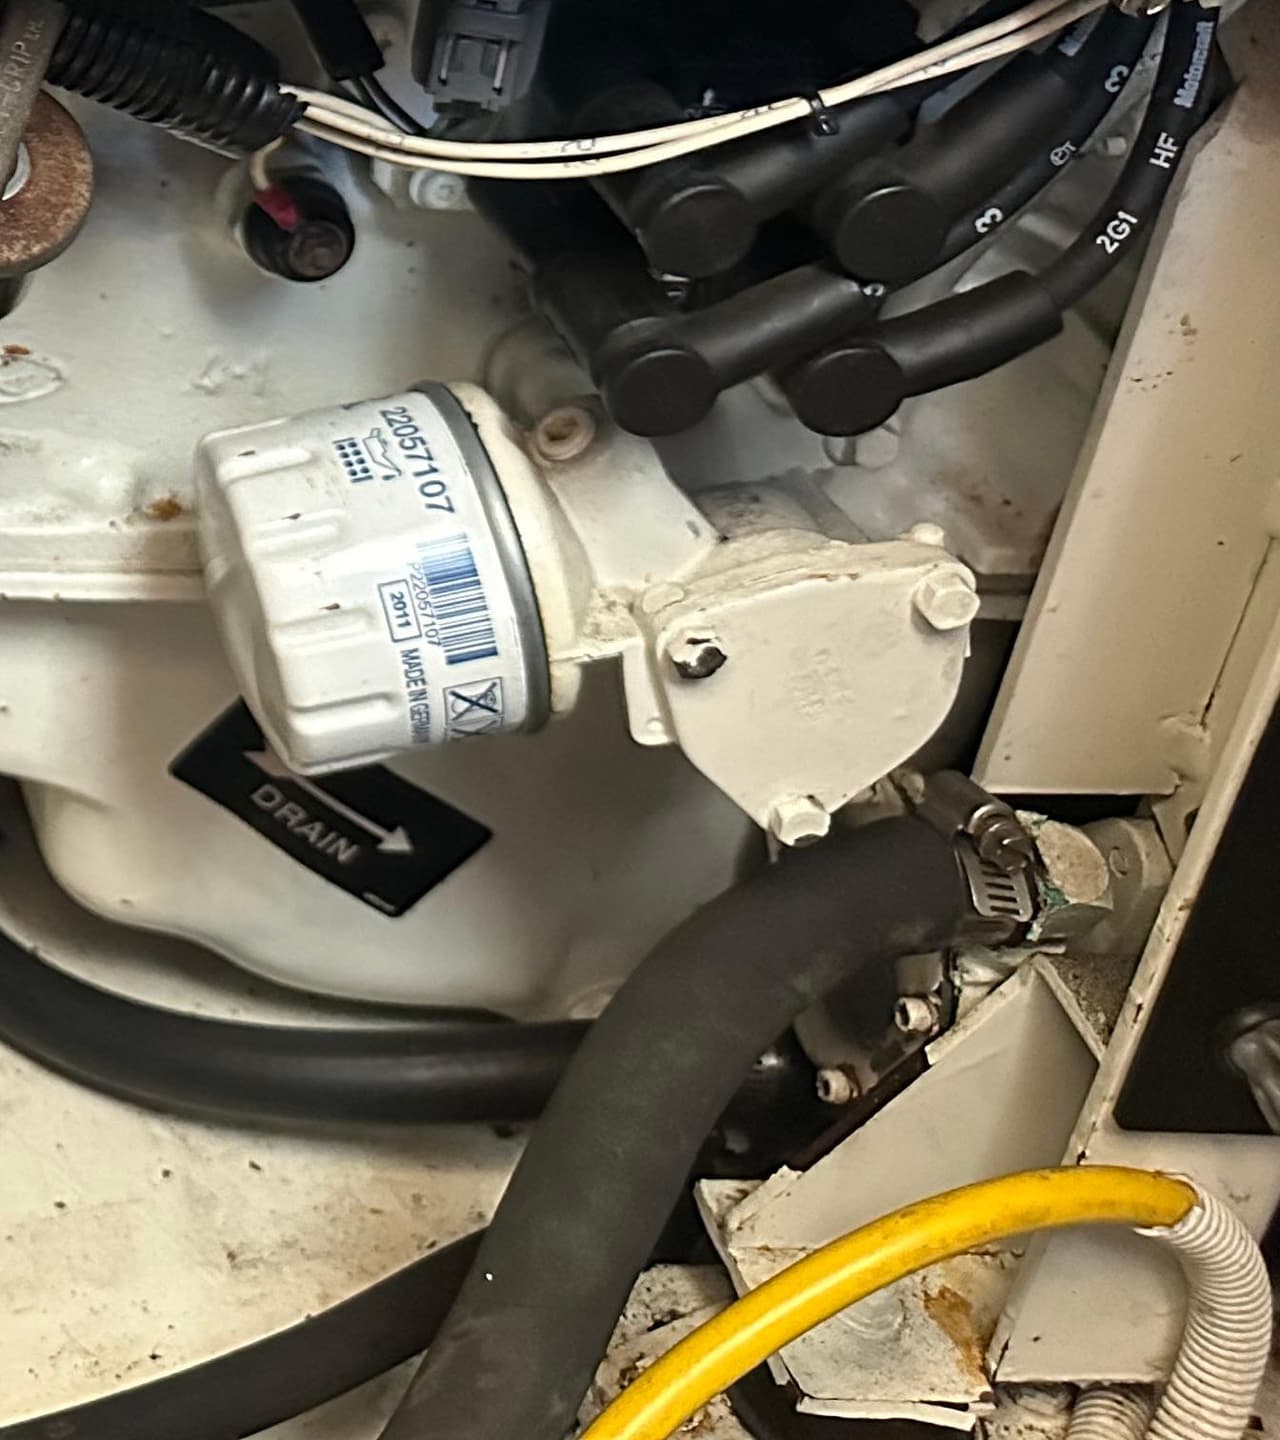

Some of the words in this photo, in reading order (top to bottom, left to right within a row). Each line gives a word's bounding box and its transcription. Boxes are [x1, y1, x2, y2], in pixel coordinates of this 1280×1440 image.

[1104, 64, 1130, 94] 3
[1149, 132, 1180, 169] HF
[973, 206, 1005, 235] 3
[1095, 210, 1140, 256] 2G1
[379, 405, 456, 514] 22057107
[389, 590, 412, 630] 2011
[400, 647, 427, 687] MADE
[407, 687, 429, 702] IN
[250, 782, 361, 863] DRAIN
